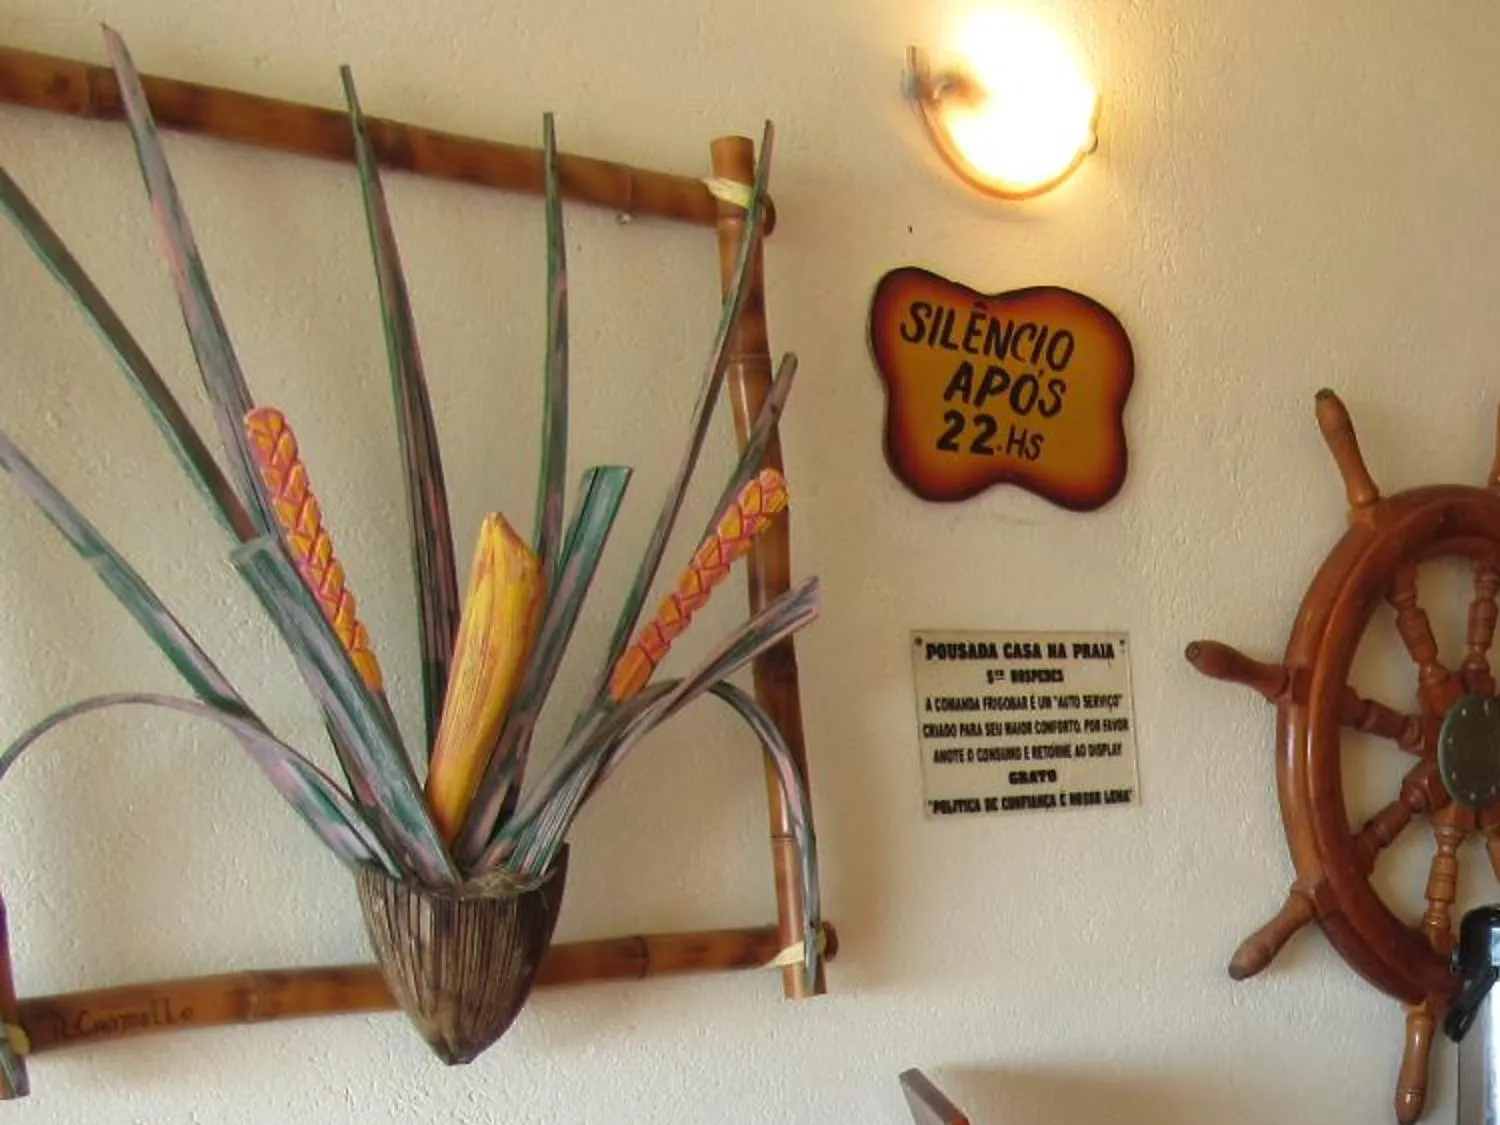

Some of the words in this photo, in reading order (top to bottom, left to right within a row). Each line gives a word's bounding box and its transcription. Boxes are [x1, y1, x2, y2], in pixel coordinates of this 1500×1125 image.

[900, 300, 1075, 372] SILÊNCIO
[943, 360, 1067, 418] APÓS
[926, 643, 998, 660] POUSADA
[1003, 643, 1042, 659] CASA
[1073, 643, 1115, 660] PRAIA
[959, 723, 982, 737] PARA
[985, 722, 1002, 736] SEU
[1008, 769, 1057, 784] GRATO
